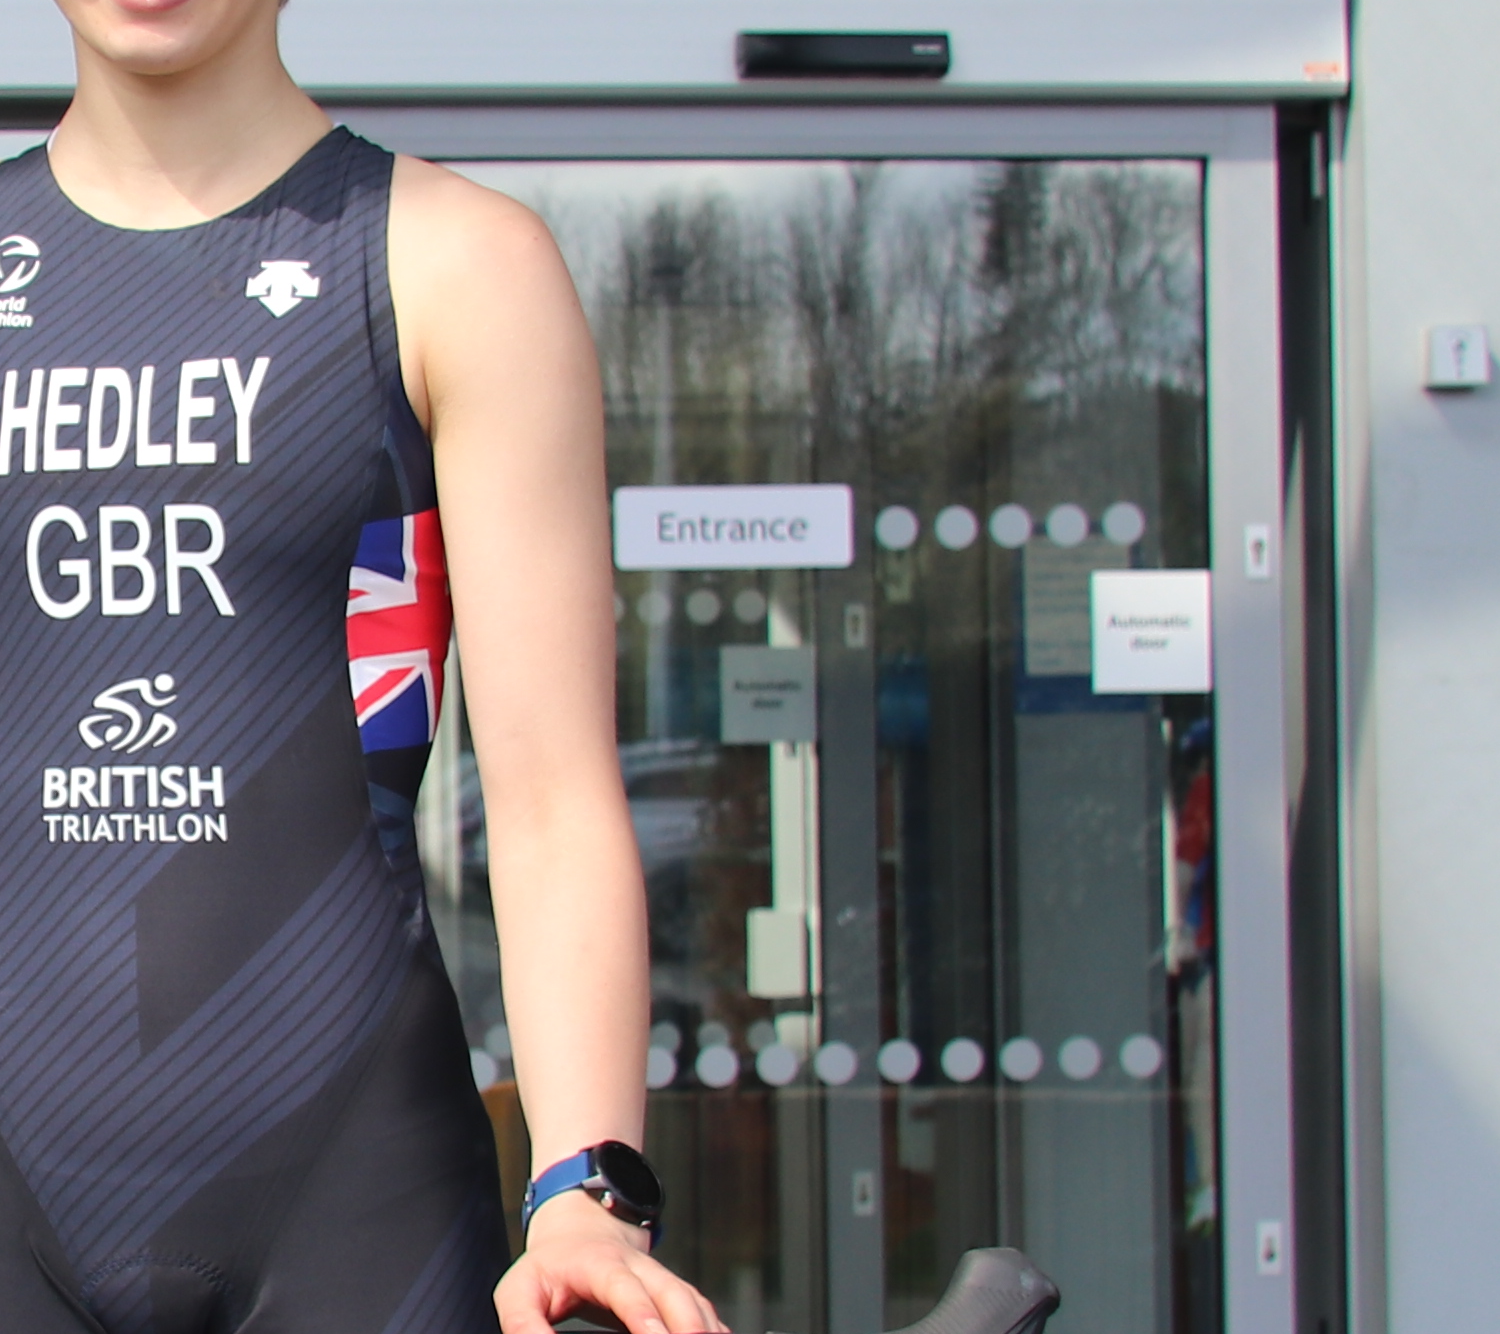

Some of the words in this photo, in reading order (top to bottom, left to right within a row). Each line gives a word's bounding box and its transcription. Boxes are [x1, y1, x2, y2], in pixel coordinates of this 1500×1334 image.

[657, 512, 808, 543] Entrance
[26, 504, 236, 620] GBR
[1106, 614, 1191, 629] Automatic
[1130, 637, 1169, 651] door
[42, 766, 225, 809] BRITISH
[42, 814, 229, 844] TRIATHLON
